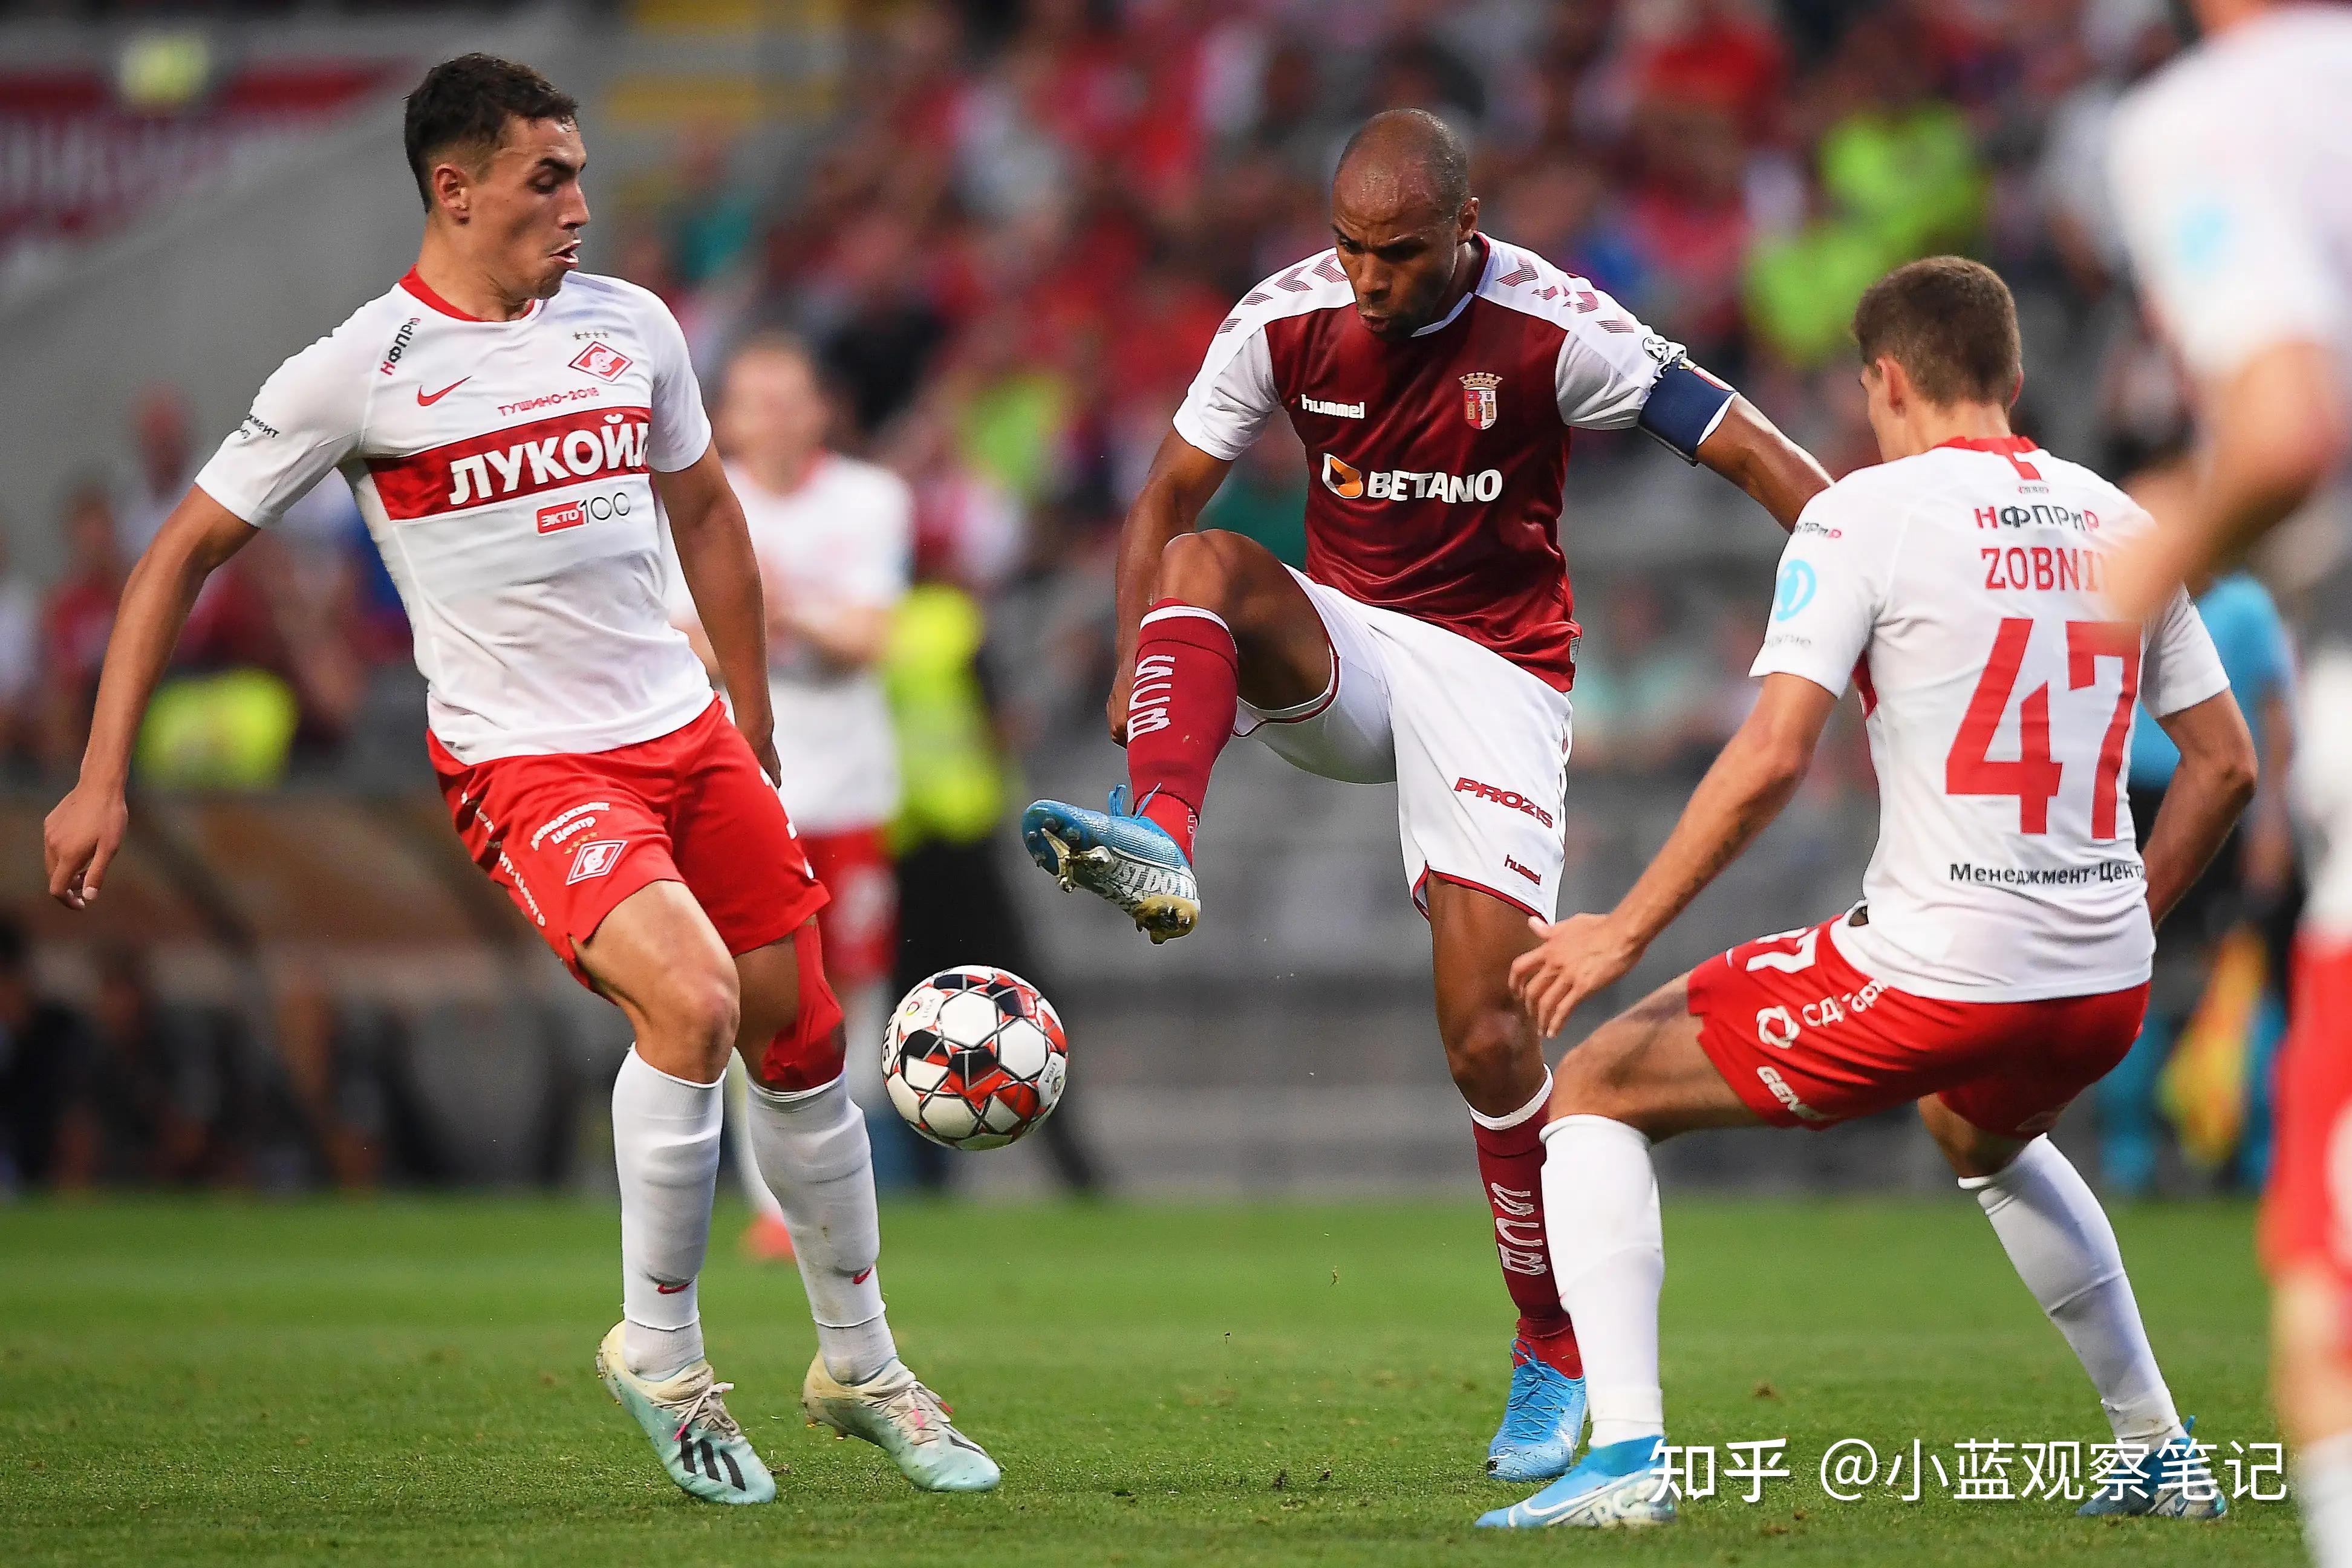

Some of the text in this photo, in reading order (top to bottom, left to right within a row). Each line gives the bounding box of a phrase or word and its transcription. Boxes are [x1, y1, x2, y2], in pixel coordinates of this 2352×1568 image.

[1301, 394, 1365, 419] hummel
[541, 491, 631, 528] ЭКТО 100
[1367, 469, 1503, 504] BETANO
[1981, 546, 2107, 591] ZOBNI
[1127, 655, 1176, 743] SCB
[1945, 617, 2142, 840] 47
[1454, 777, 1554, 829] PROZIS
[1491, 1182, 1548, 1275] SCB
